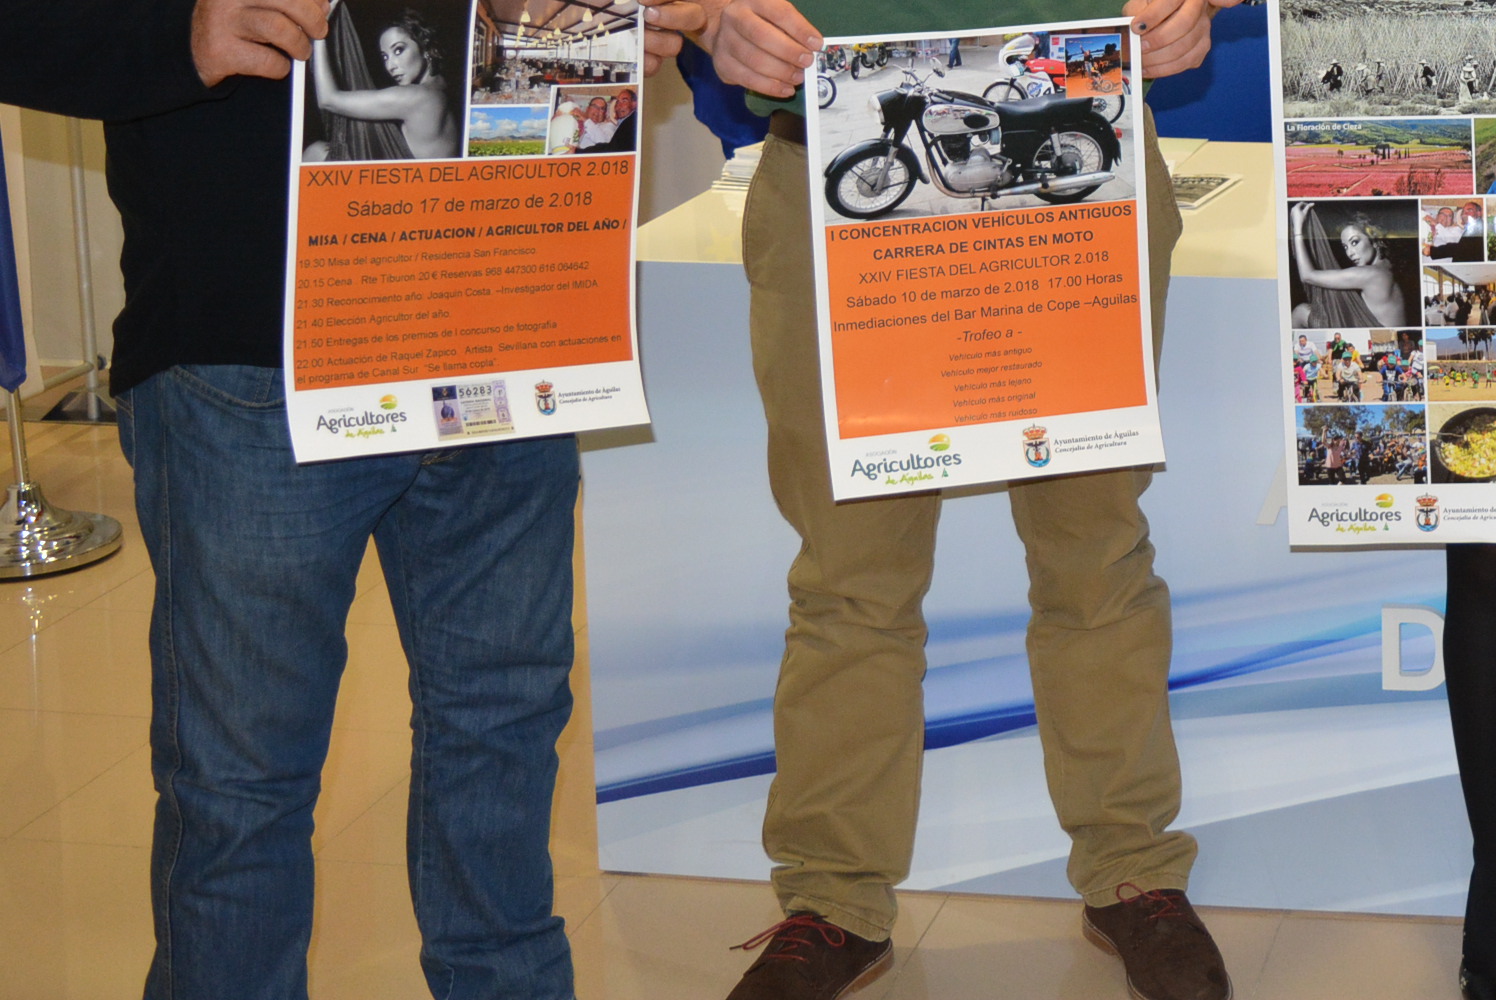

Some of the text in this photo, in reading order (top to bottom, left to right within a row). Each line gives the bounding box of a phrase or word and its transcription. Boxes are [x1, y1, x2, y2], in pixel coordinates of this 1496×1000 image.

[306, 159, 628, 187] XXIV FIESTA DEL AGRICULTOR 2.018
[346, 190, 592, 217] Sábado 17 de marzo de 2.018
[307, 234, 338, 247] MISA
[350, 231, 387, 244] CENA
[398, 226, 475, 242] ACTUACION
[485, 221, 564, 237] AGRICULTOR
[566, 220, 589, 232] DEL
[592, 217, 620, 231] AÑO
[830, 204, 1131, 241] I CONCENTRACION VEHÍCULOS ANTIGUOS
[872, 229, 1093, 260] CARRERA DE CINTAS EN MOTO
[858, 249, 1109, 284] XXIV FIESTA DEL AGRICULTOR 2.018
[845, 273, 1123, 308] Sábado 10 de marzo de 2.018 17.00 Horas
[325, 315, 367, 327] Elección
[368, 311, 413, 326] Agricultor
[415, 310, 430, 320] del
[833, 314, 927, 332] Inmediaciones
[930, 309, 950, 323] del
[953, 308, 976, 320] Bar
[979, 304, 1023, 318] Marina
[1026, 301, 1043, 313] de
[1046, 299, 1080, 312] Cope
[1004, 328, 1013, 338] a
[458, 385, 492, 397] 56283
[316, 408, 407, 434] Agricultores
[850, 450, 962, 480] Agricultores
[1307, 506, 1402, 527] Agricultores
[1381, 606, 1446, 691] D
